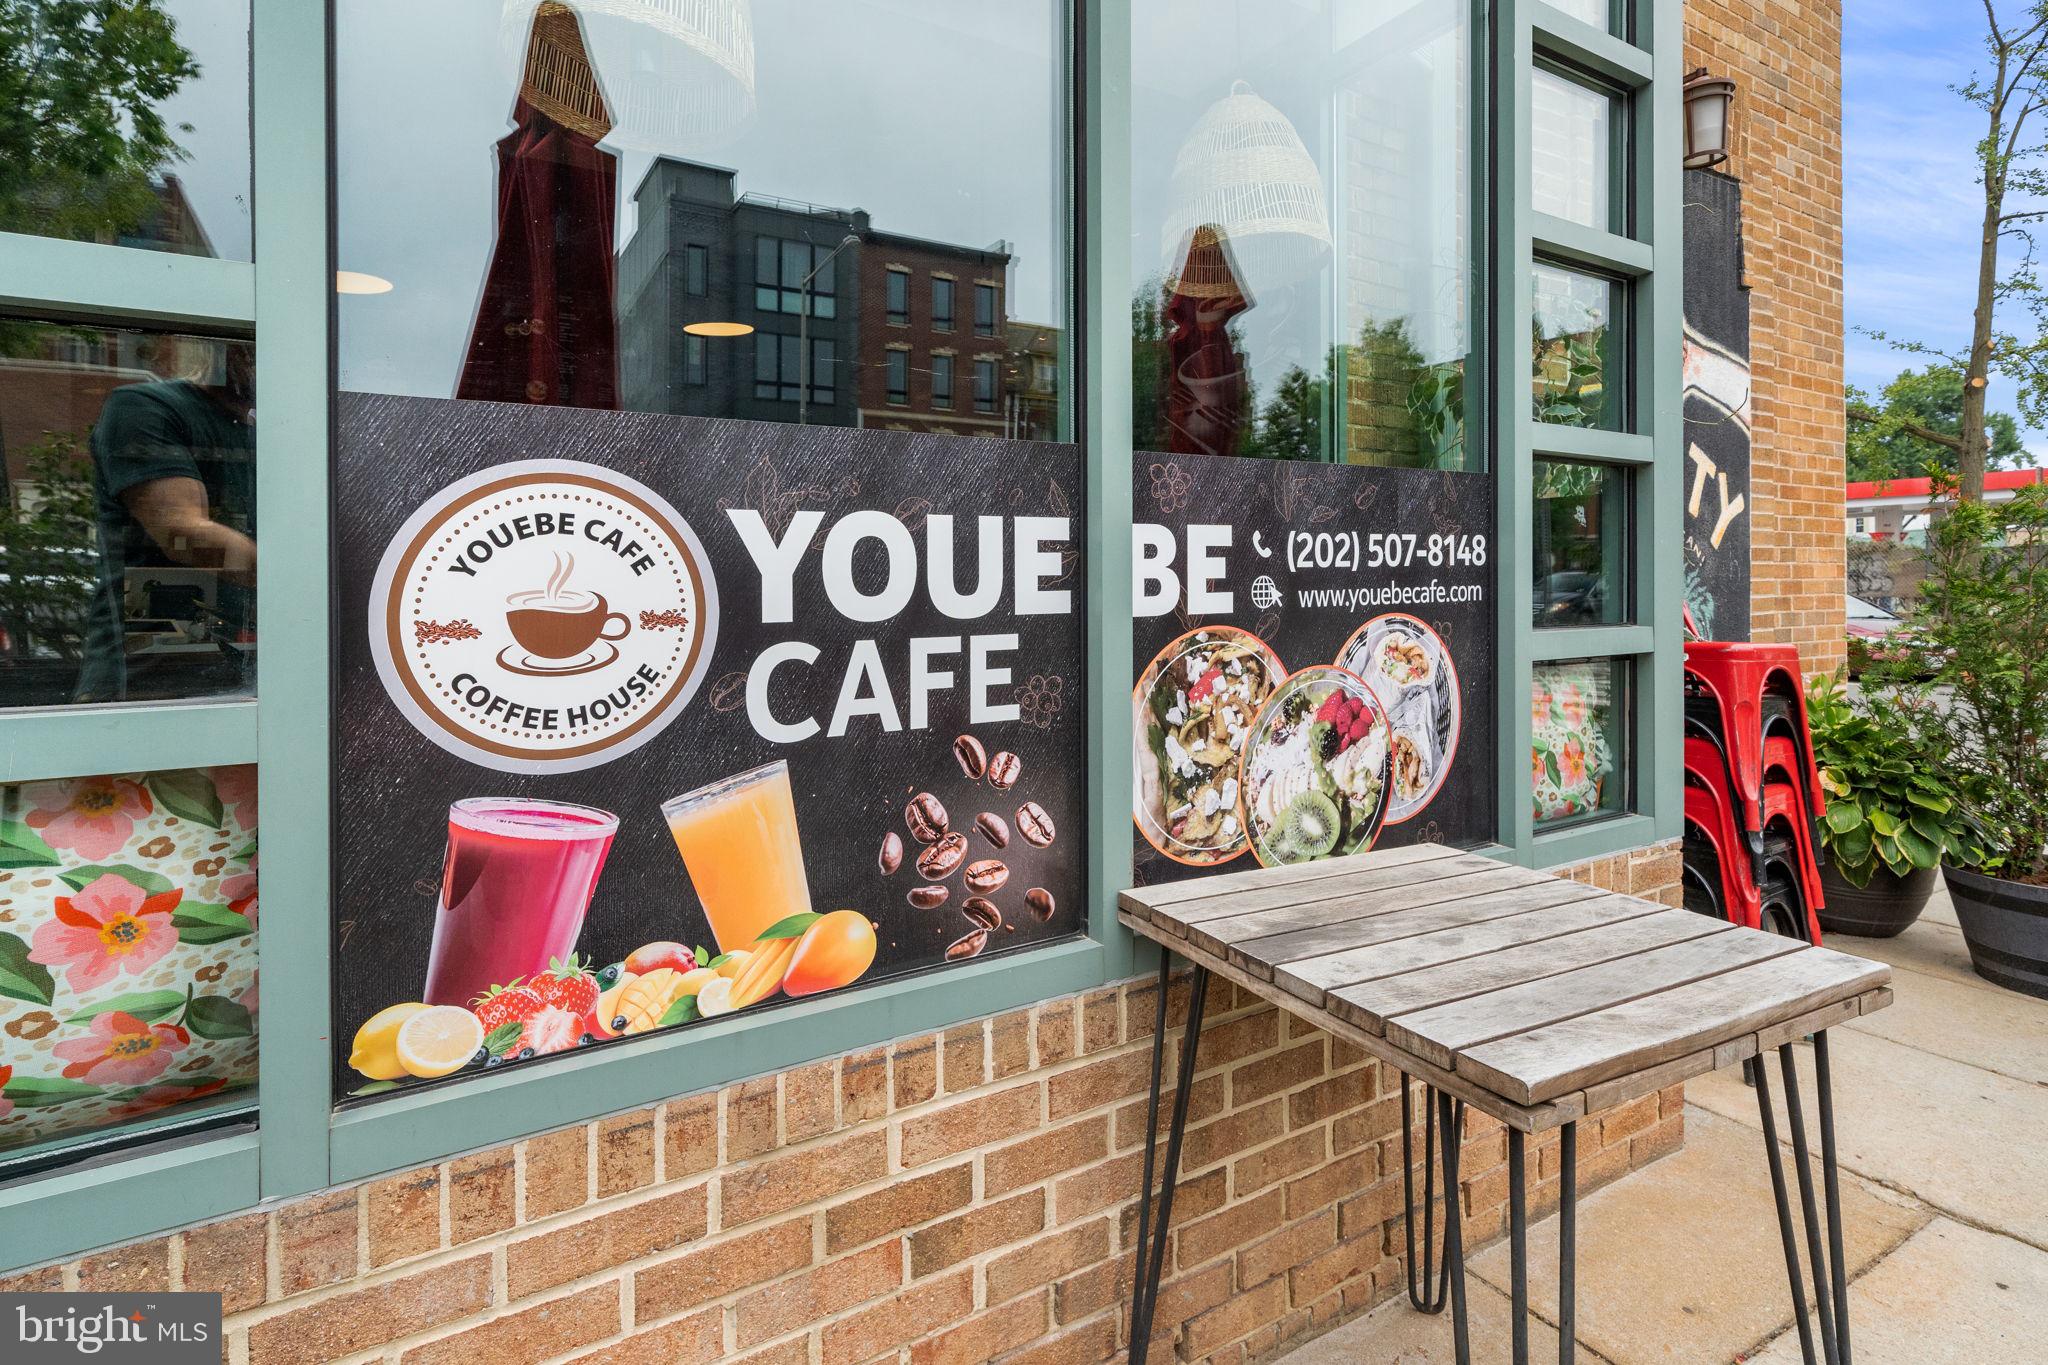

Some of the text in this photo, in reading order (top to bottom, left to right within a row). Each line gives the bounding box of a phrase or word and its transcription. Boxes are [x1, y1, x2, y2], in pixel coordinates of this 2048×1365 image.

[1688, 441, 1745, 550] TY
[447, 512, 656, 578] YOUEBE CAFE
[725, 508, 1072, 624] YOUE
[1132, 523, 1234, 618] BE
[1287, 530, 1487, 573] (202) 507-8148
[1298, 578, 1483, 613] www.youebecafe.com
[450, 662, 661, 731] COFFEE HOUSE
[745, 633, 1021, 744] CAFE
